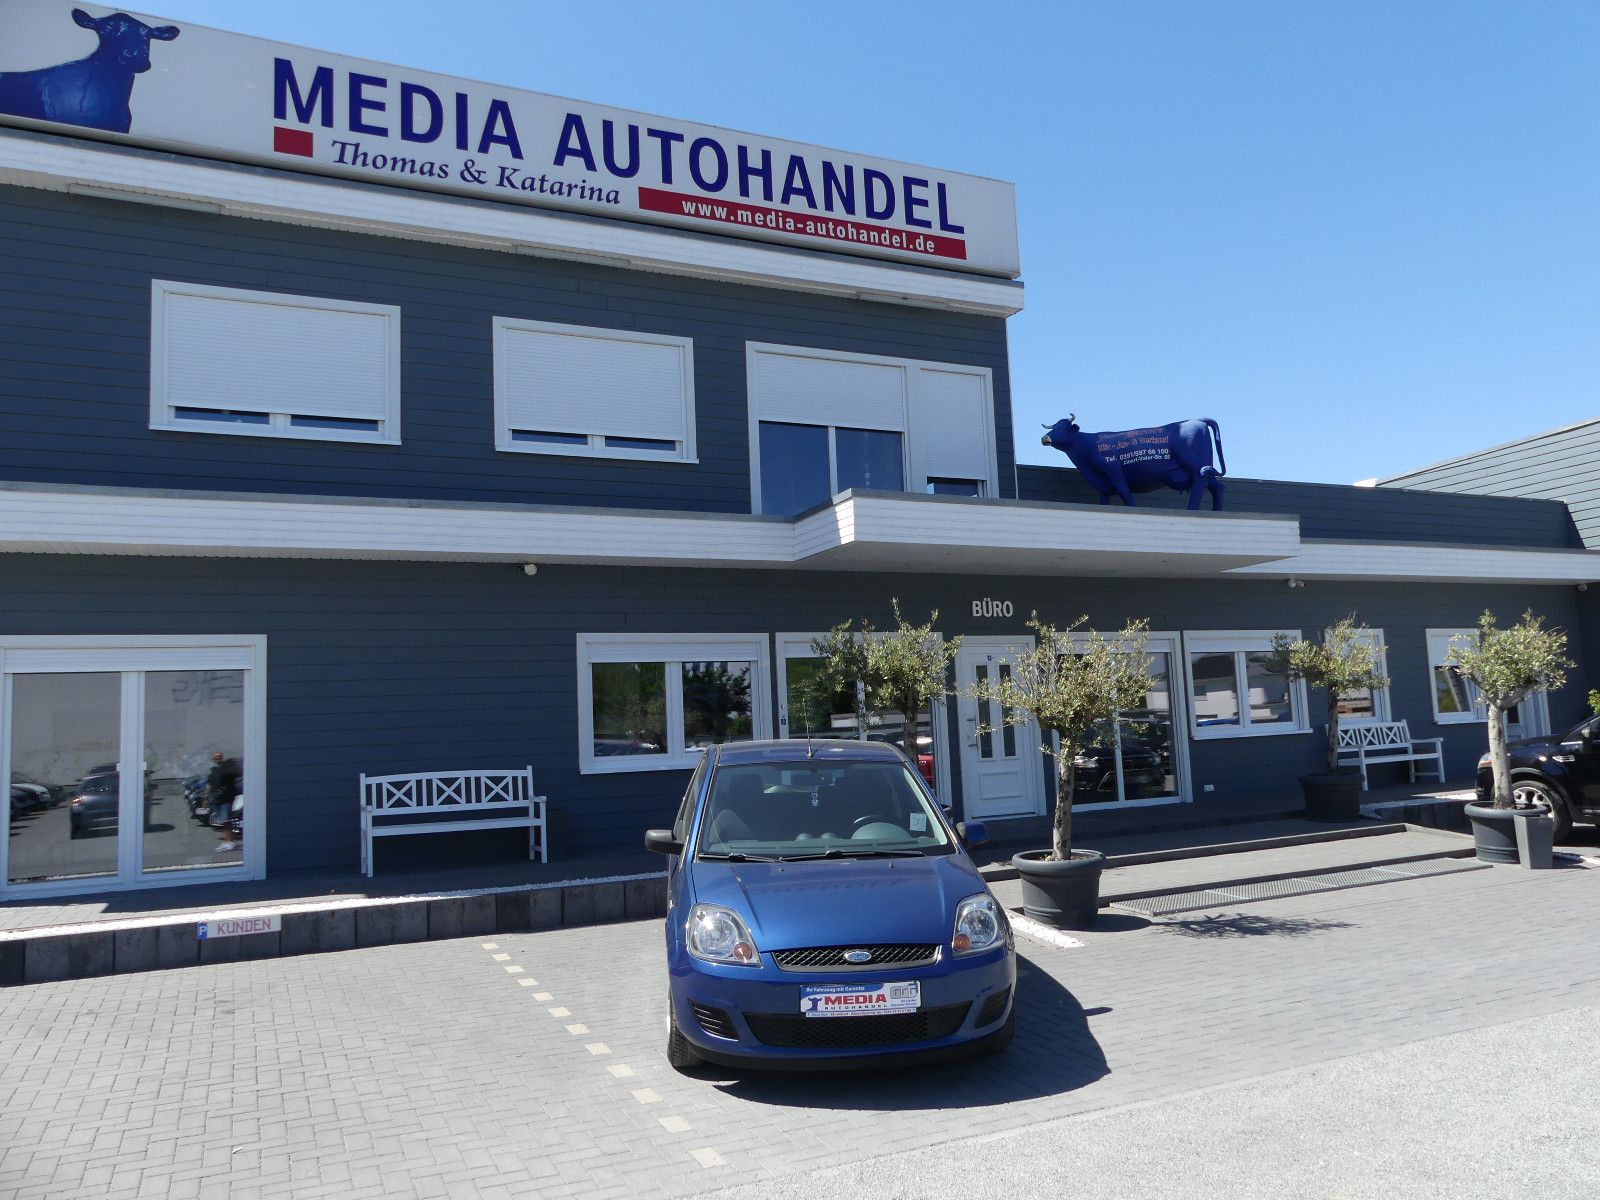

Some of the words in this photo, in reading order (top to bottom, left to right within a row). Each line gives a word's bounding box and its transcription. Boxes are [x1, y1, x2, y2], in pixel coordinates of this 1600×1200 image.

[273, 57, 524, 160] MEDIA
[553, 112, 965, 235] AUTOHANDEL
[331, 140, 449, 179] Thomas
[459, 159, 488, 185] &
[495, 165, 621, 205] Katarina
[681, 199, 935, 253] www.media-autohandel.de
[972, 597, 1014, 618] BÜRO
[217, 919, 271, 935] KUNDEN
[824, 993, 888, 1005] MEDIA
